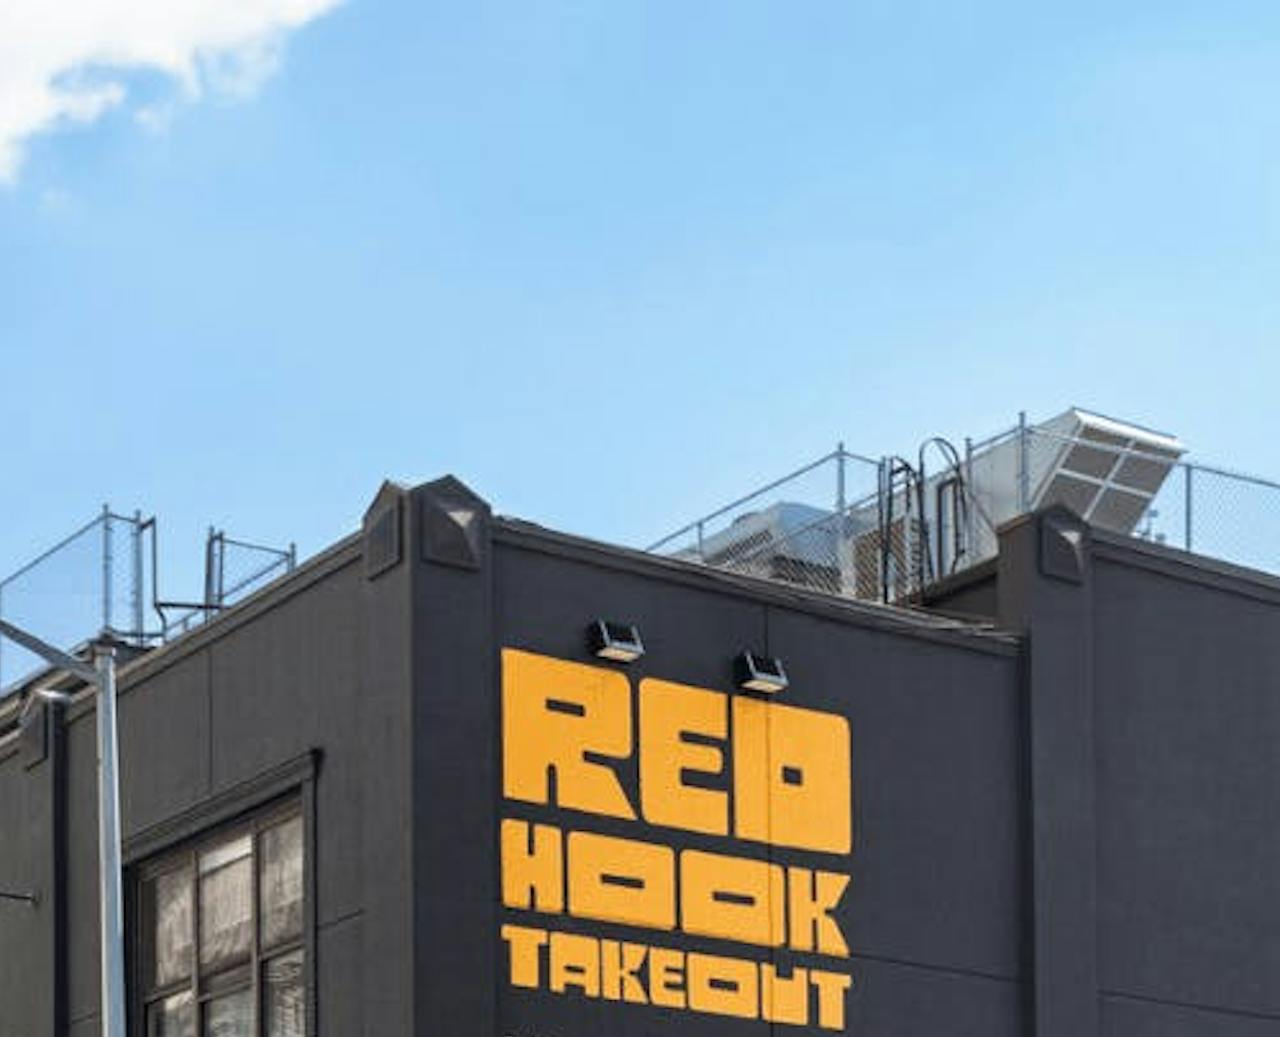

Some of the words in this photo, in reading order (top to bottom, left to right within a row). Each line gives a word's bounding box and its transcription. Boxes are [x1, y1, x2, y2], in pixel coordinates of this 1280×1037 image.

[501, 648, 852, 855] RED
[500, 818, 850, 958] HOOK
[501, 924, 851, 1031] TAKEOUT
